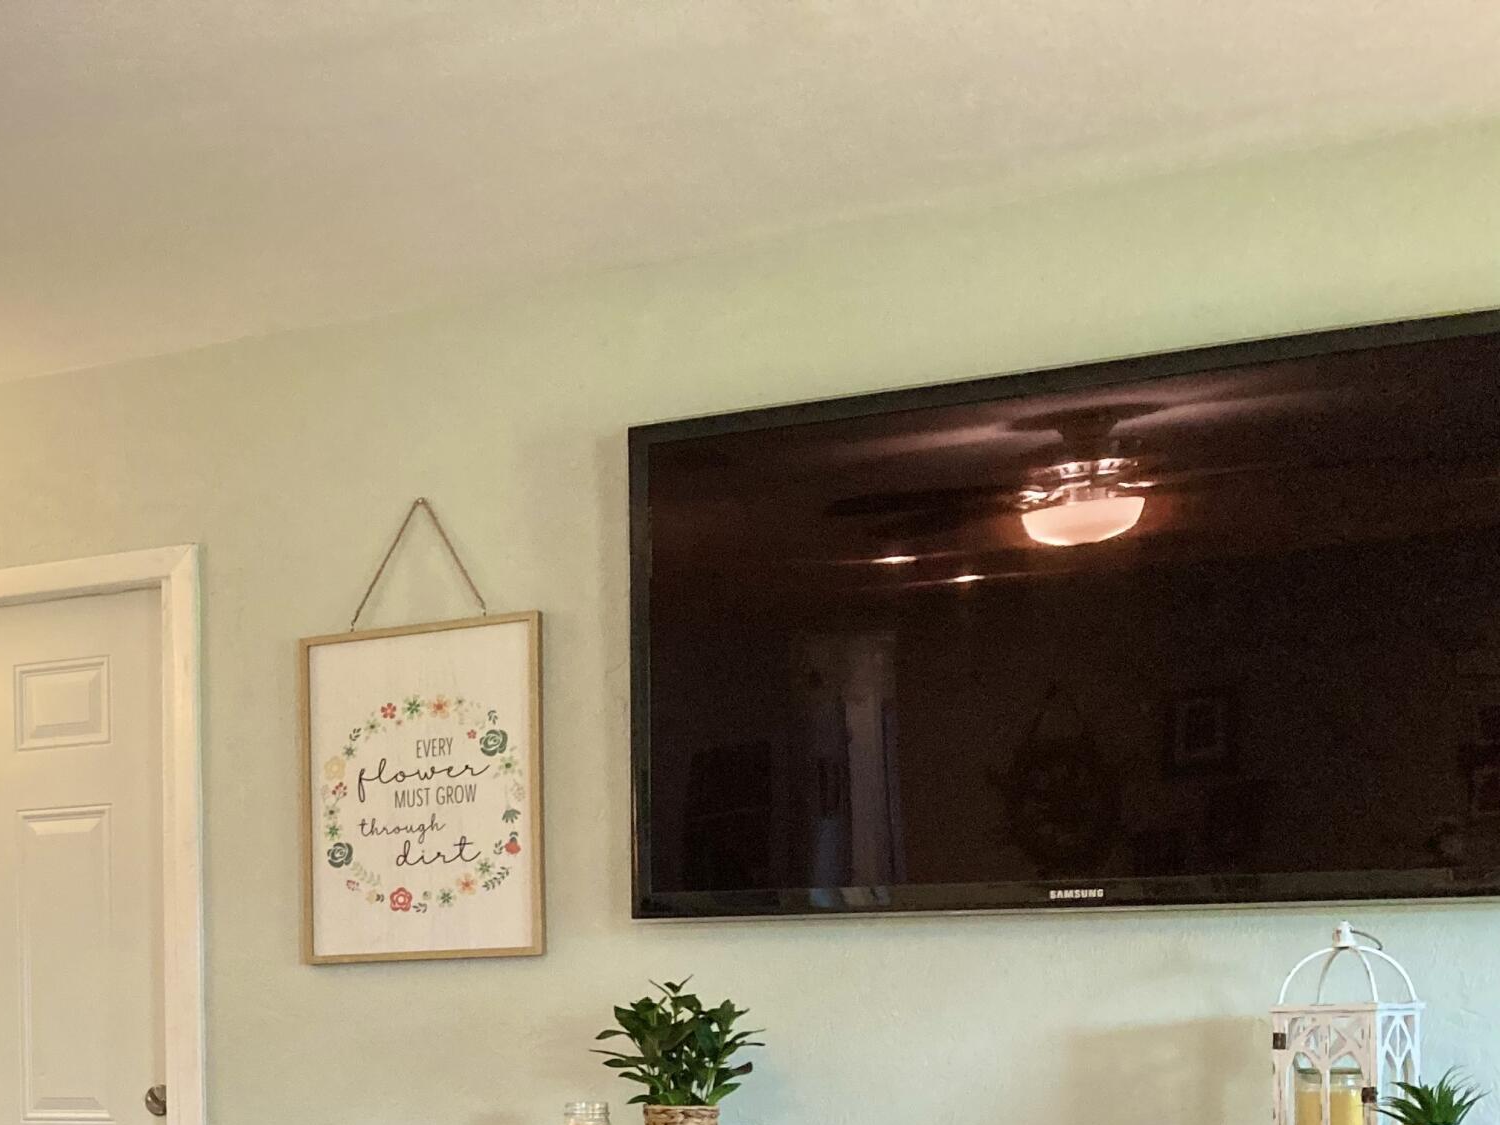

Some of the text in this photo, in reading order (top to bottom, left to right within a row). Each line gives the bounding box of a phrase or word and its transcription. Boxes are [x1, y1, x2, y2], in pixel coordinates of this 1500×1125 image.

[416, 737, 453, 759] EVERY
[357, 757, 490, 804] flower
[394, 784, 477, 809] MUST GROW
[359, 813, 446, 844] through
[396, 835, 483, 868] dirt
[1049, 888, 1104, 900] SAMSUNG
